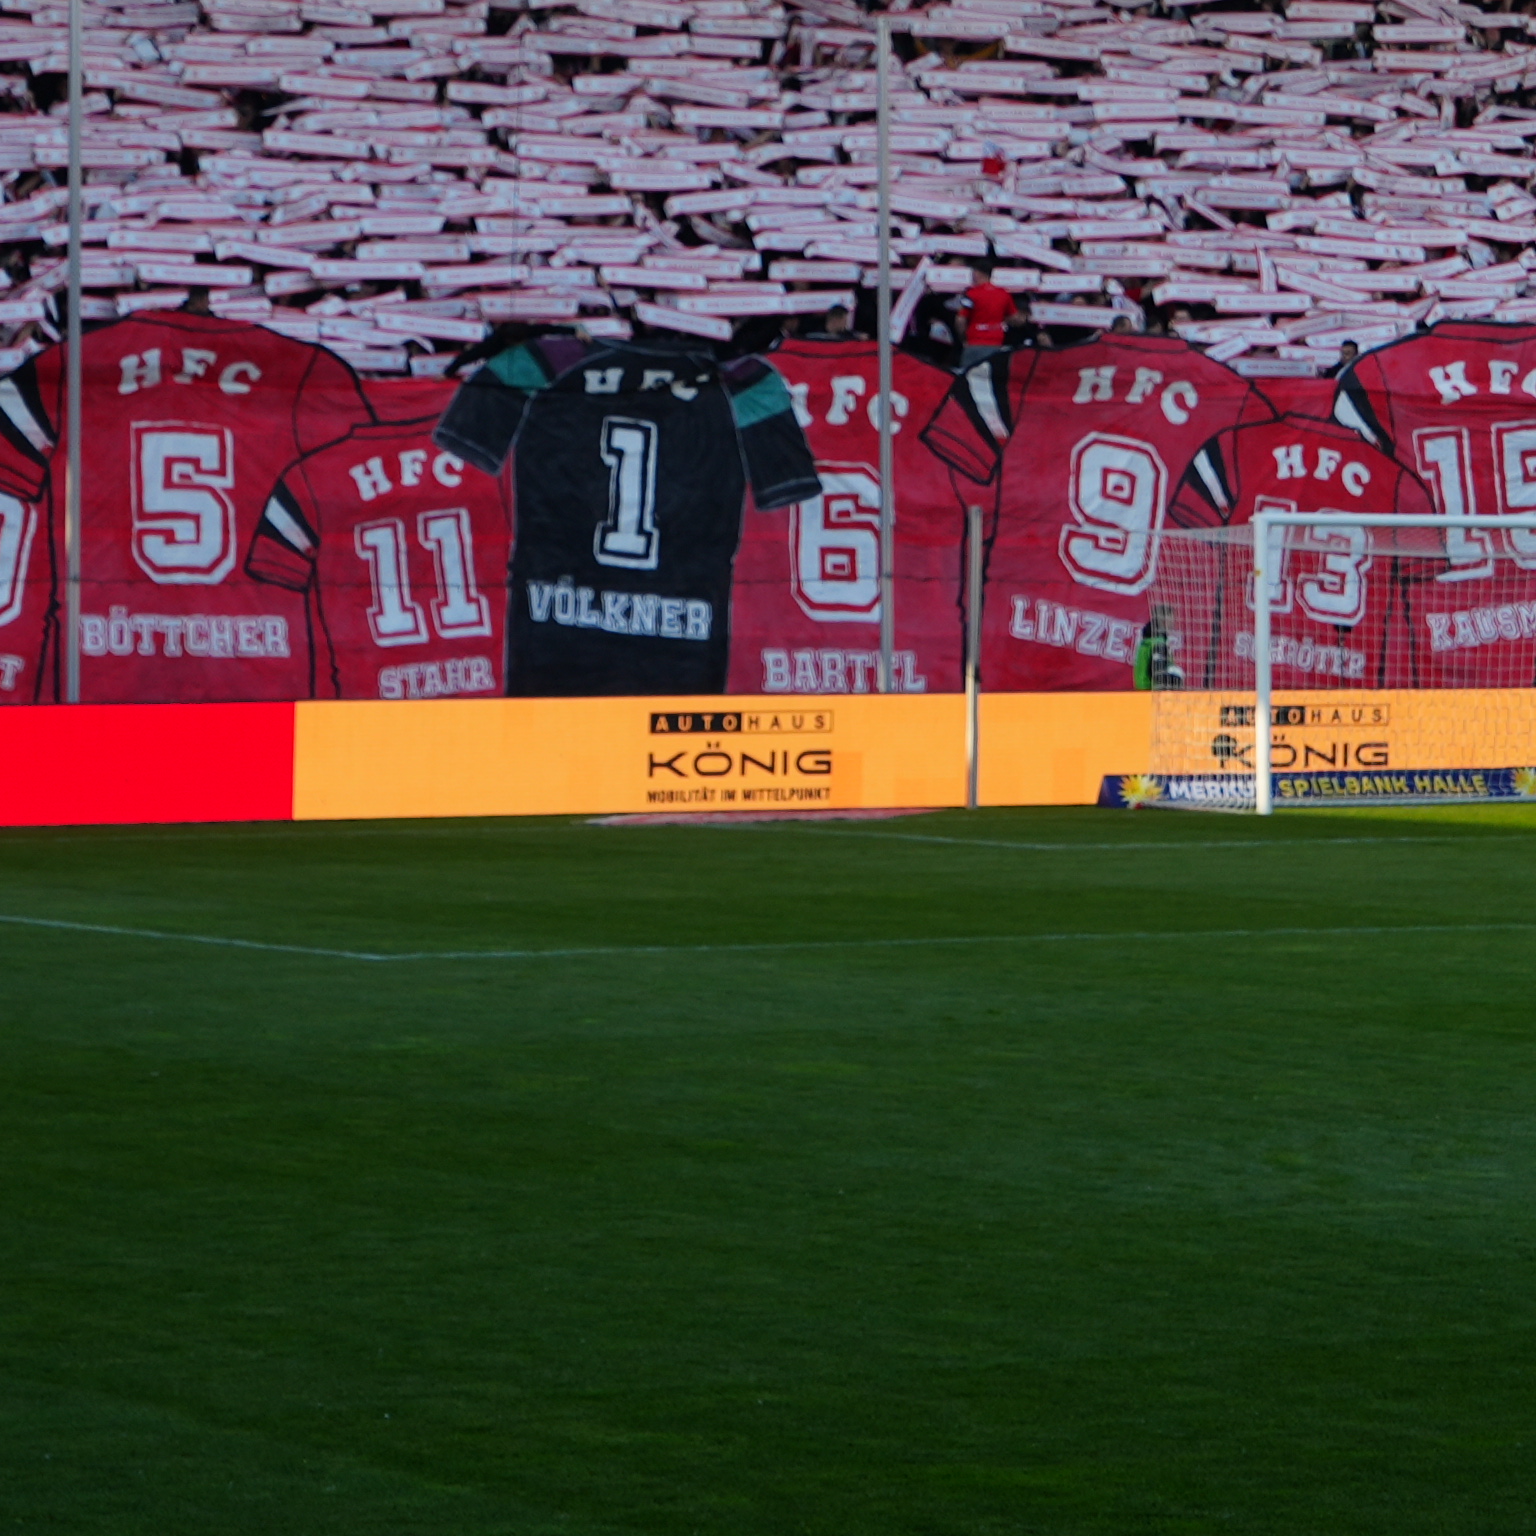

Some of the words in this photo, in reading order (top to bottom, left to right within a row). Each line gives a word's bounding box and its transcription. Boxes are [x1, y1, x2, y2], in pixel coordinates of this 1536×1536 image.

[117, 346, 261, 396] HFC
[1072, 364, 1199, 426] HFC
[349, 448, 466, 500] HFC
[593, 416, 659, 571] 1
[1272, 444, 1371, 497] HFC
[130, 419, 237, 587] 5
[1058, 430, 1169, 597] 9
[789, 460, 896, 623] 6
[1246, 494, 1374, 628] 13
[355, 507, 493, 648] 11
[79, 606, 291, 658] BÖTTCHER
[526, 575, 712, 641] VÖLKNER
[378, 656, 497, 700] STAHR
[654, 714, 825, 732] AUTOHAUS
[648, 740, 832, 778] KÖNIG
[1168, 779, 1275, 800] MERKU
[1278, 775, 1409, 798] SPIELBANK
[1416, 773, 1490, 795] HALLE
